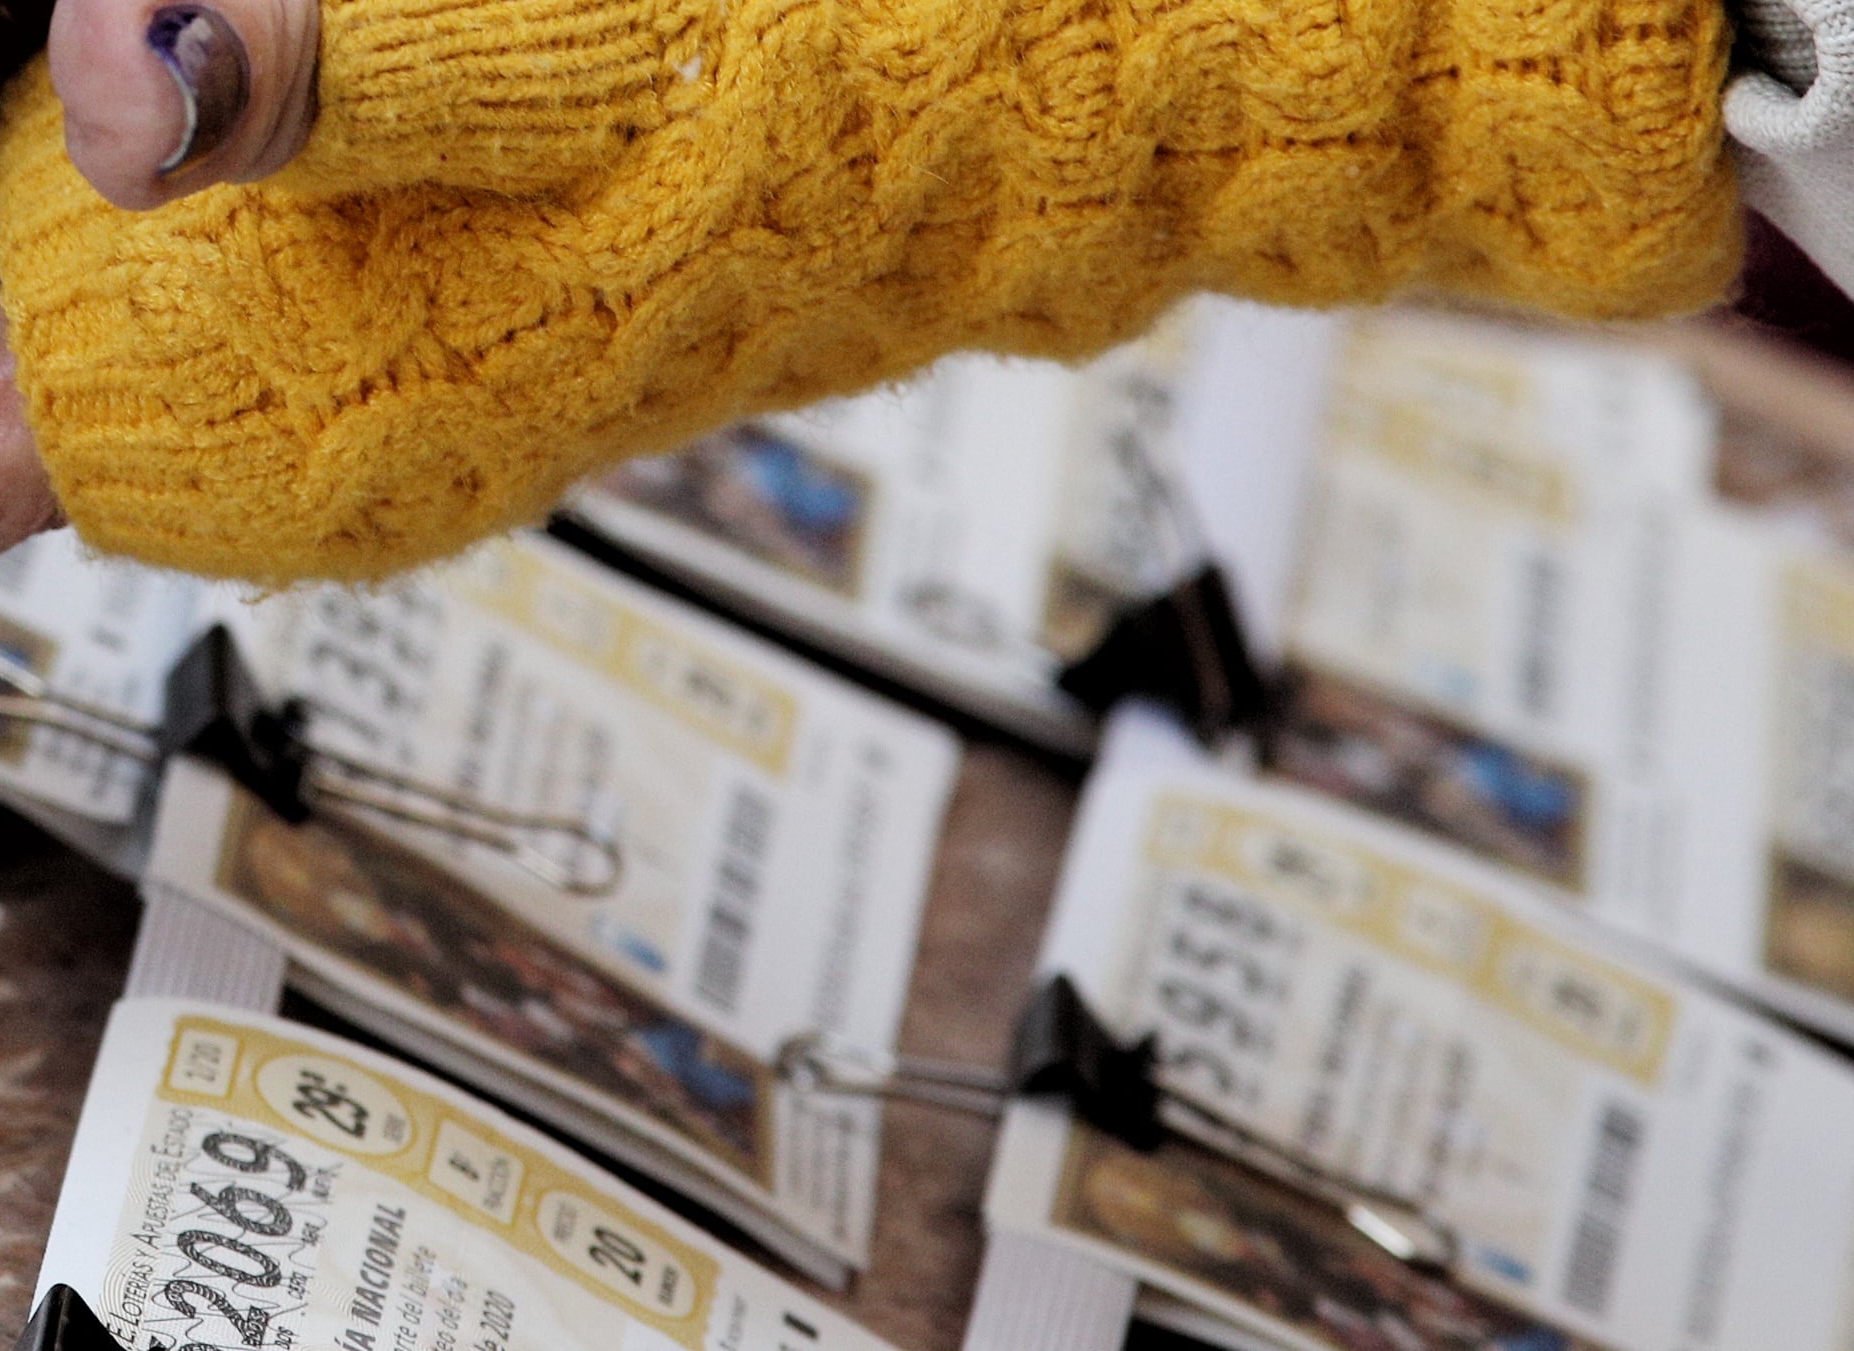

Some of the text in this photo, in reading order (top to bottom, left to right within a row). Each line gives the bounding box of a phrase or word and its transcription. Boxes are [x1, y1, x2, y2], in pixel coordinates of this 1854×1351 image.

[150, 1105, 195, 1159] ESTADO
[153, 1160, 186, 1183] DEL
[131, 1182, 177, 1251] APUESTAS
[134, 1247, 158, 1261] Y
[350, 1203, 407, 1327] NACIONAL
[401, 1245, 438, 1300] billete
[587, 1226, 647, 1287] 20
[126, 1261, 156, 1324] LOTERÍAS
[395, 1295, 424, 1326] del
[435, 1297, 462, 1331] del
[478, 1289, 516, 1343] 2020
